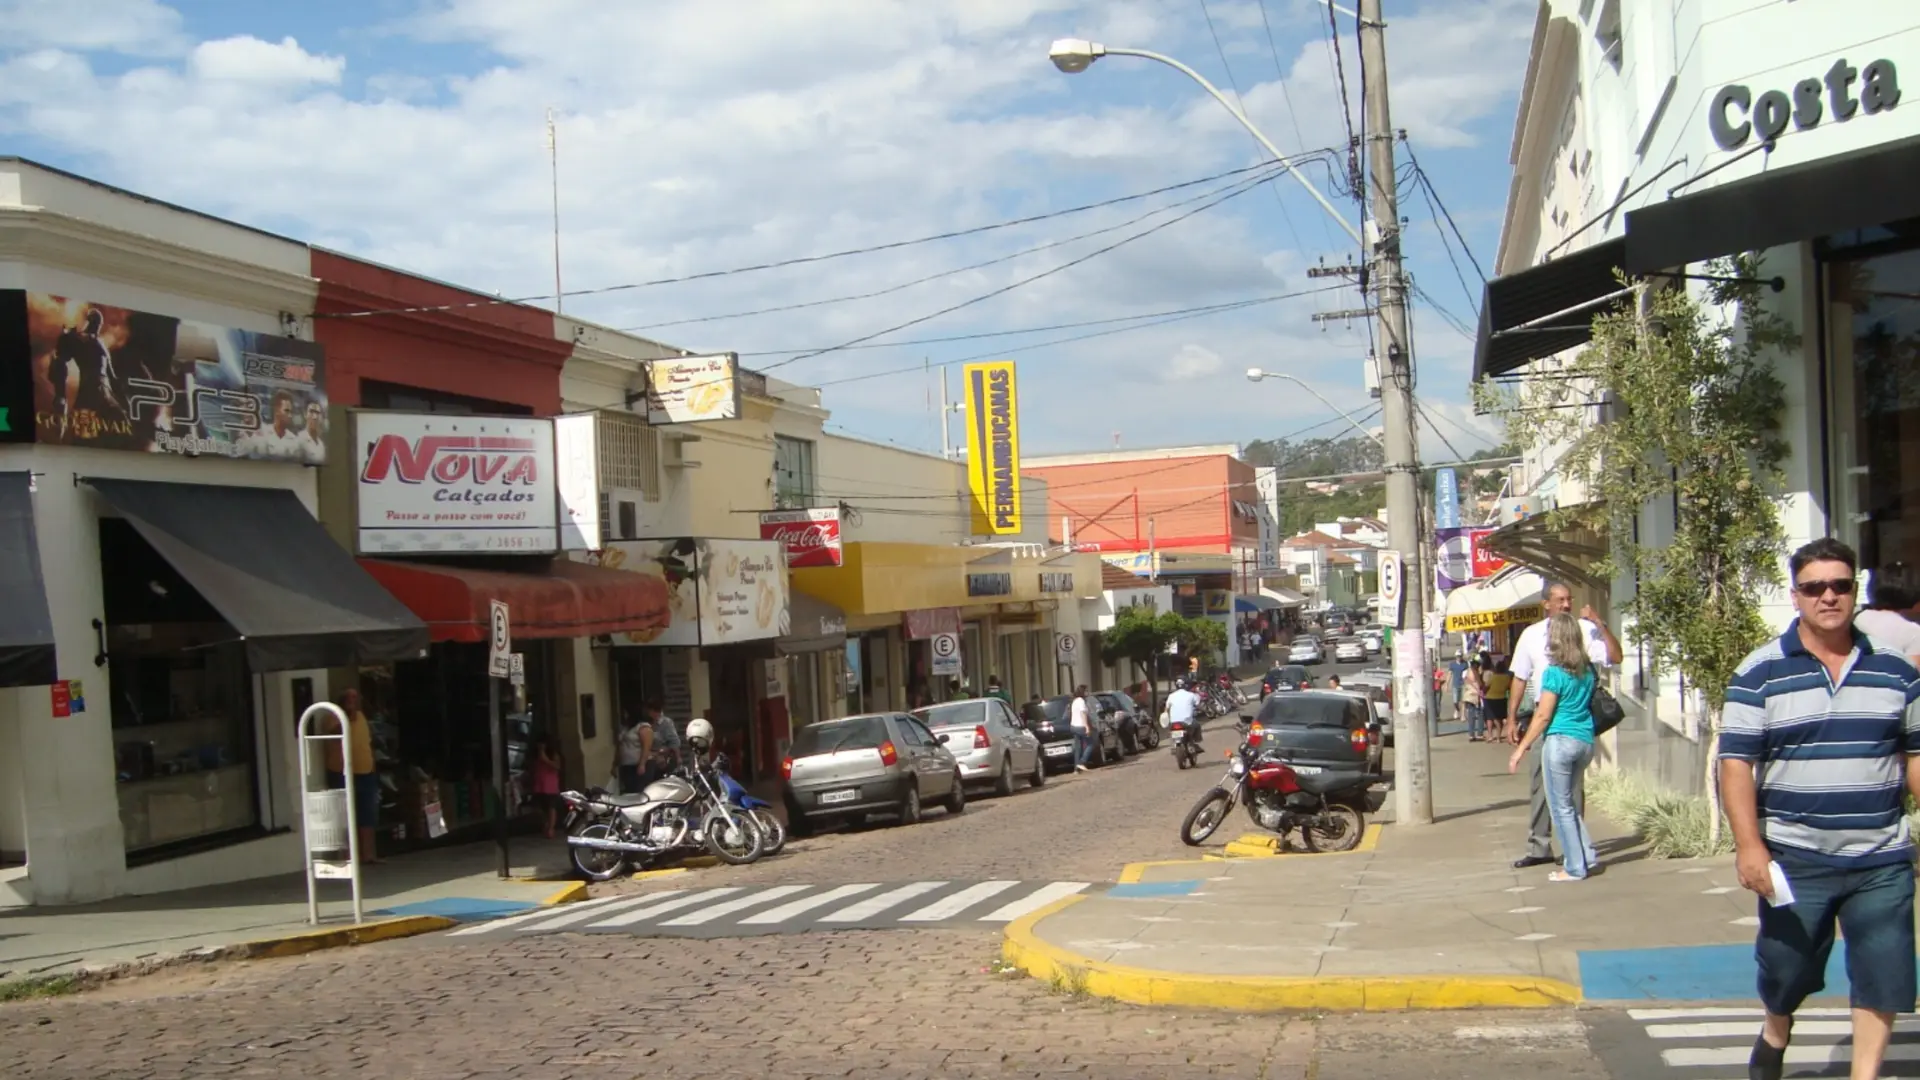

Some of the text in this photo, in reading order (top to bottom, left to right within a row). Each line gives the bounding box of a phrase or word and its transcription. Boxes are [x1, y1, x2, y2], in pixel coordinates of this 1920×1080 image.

[1709, 58, 1901, 152] Costa
[128, 376, 261, 432] PS3
[361, 434, 538, 485] NOVA
[990, 369, 1016, 529] PERNAMBUCANAS
[433, 488, 535, 505] Calçados
[385, 510, 418, 521] Passo
[434, 513, 466, 522] passo
[470, 512, 494, 520] com
[1452, 607, 1538, 628] PANELA DE FERRO
[941, 639, 948, 652] E
[1065, 637, 1070, 649] E
